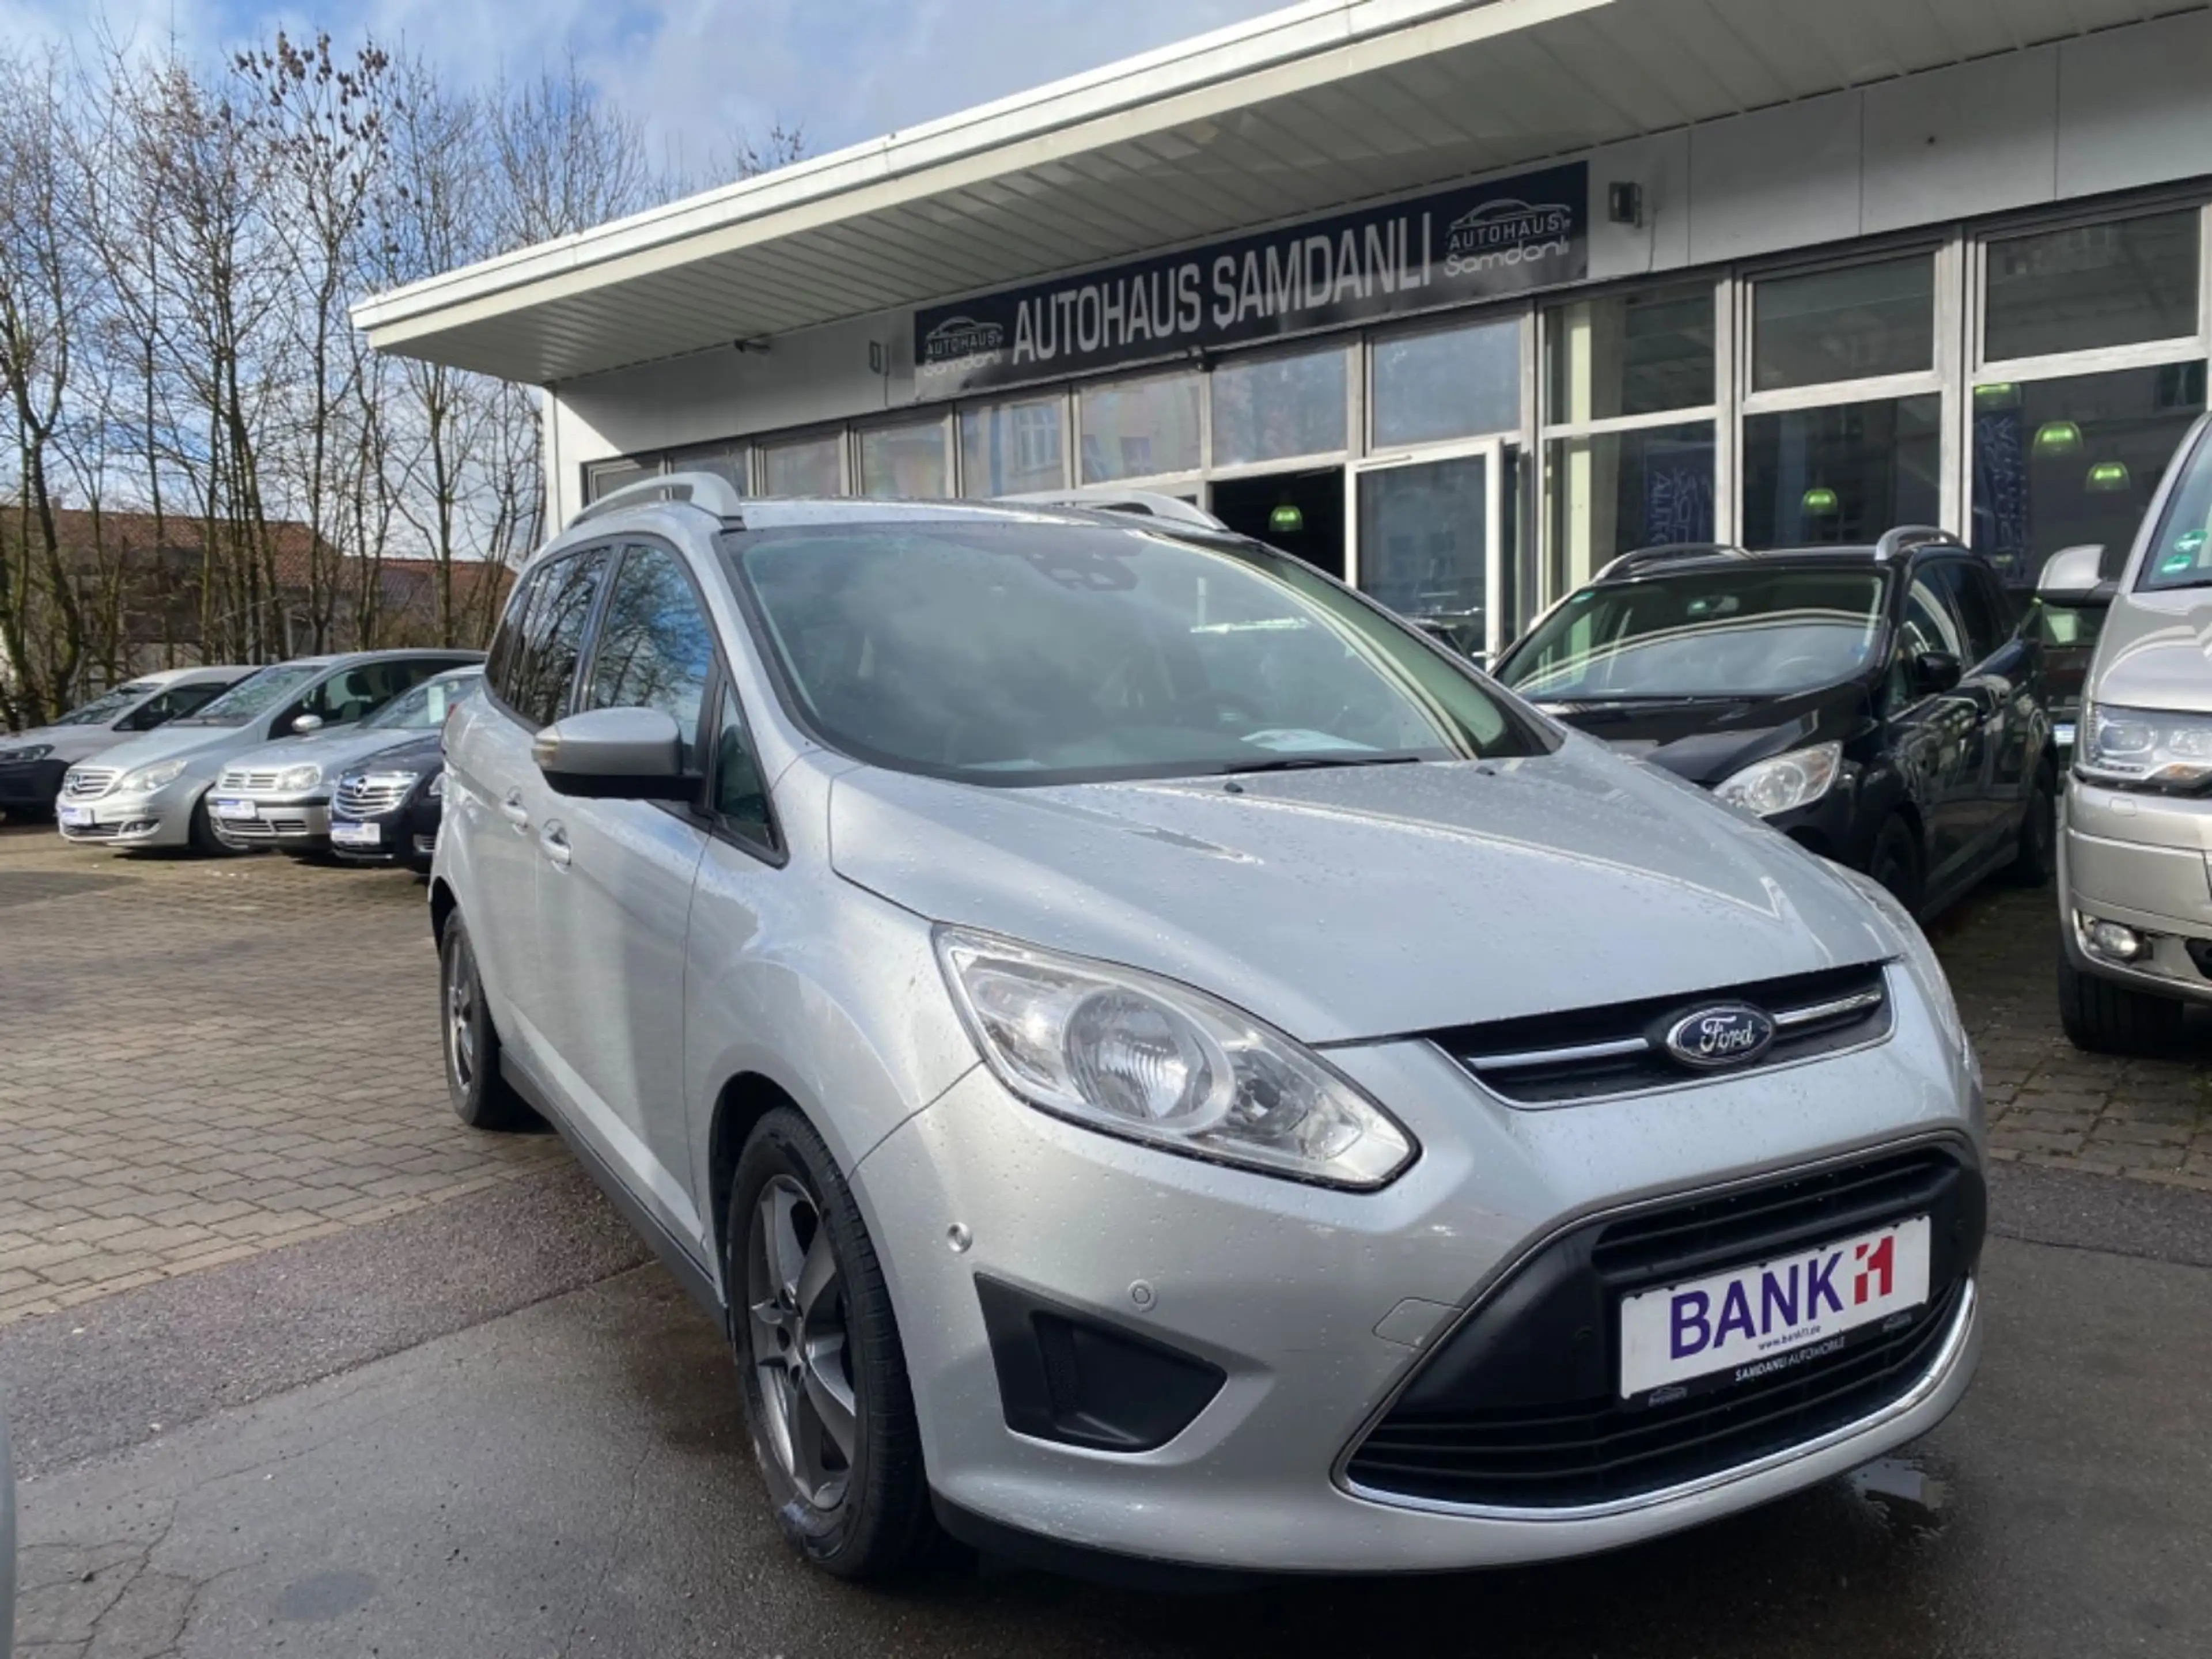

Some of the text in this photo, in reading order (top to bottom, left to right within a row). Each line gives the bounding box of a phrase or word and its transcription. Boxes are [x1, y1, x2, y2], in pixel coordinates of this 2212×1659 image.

[1449, 211, 1565, 251] AUTOHAUS
[1012, 263, 1202, 366] AUTOHAUS
[925, 329, 997, 355] AUTOHAUS
[1700, 1016, 1755, 1054] Ford
[1669, 1250, 1844, 1361] BANK
